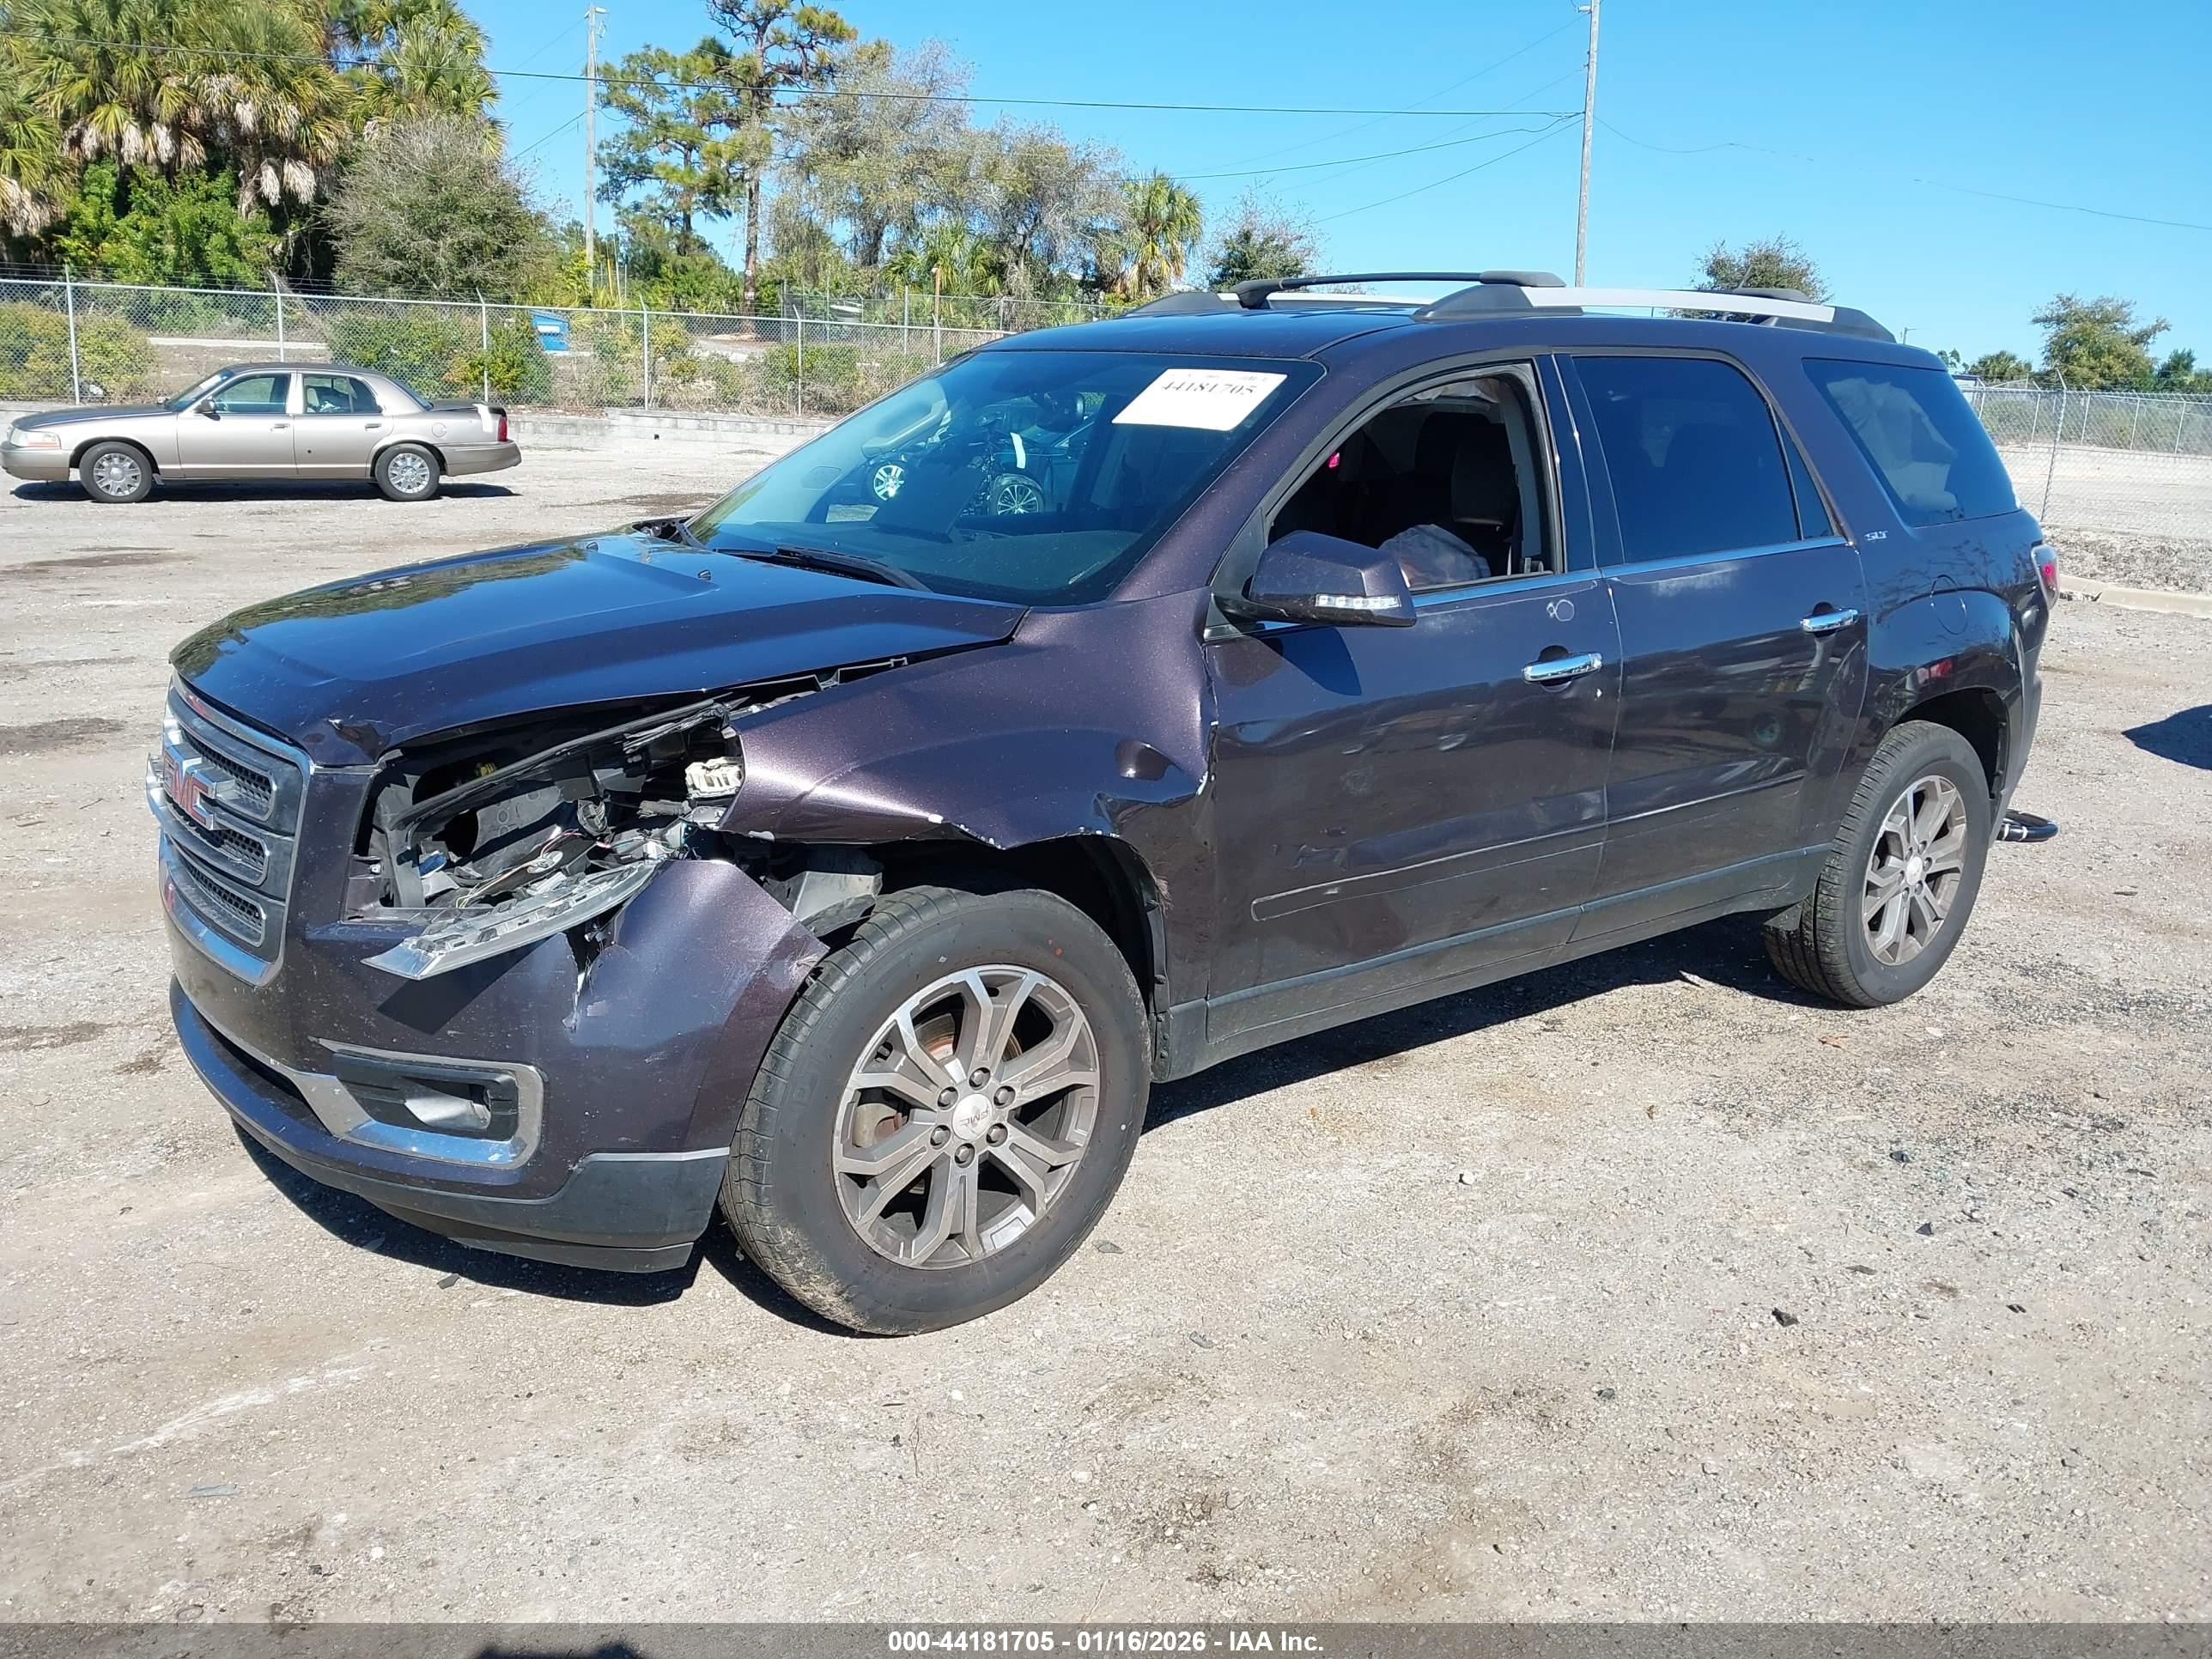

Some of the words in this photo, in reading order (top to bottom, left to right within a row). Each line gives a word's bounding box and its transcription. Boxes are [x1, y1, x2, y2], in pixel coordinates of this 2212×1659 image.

[1162, 380, 1258, 396] 44181705
[1863, 530, 1888, 541] SLT
[163, 747, 217, 830] GMC
[958, 1104, 990, 1127] GMC
